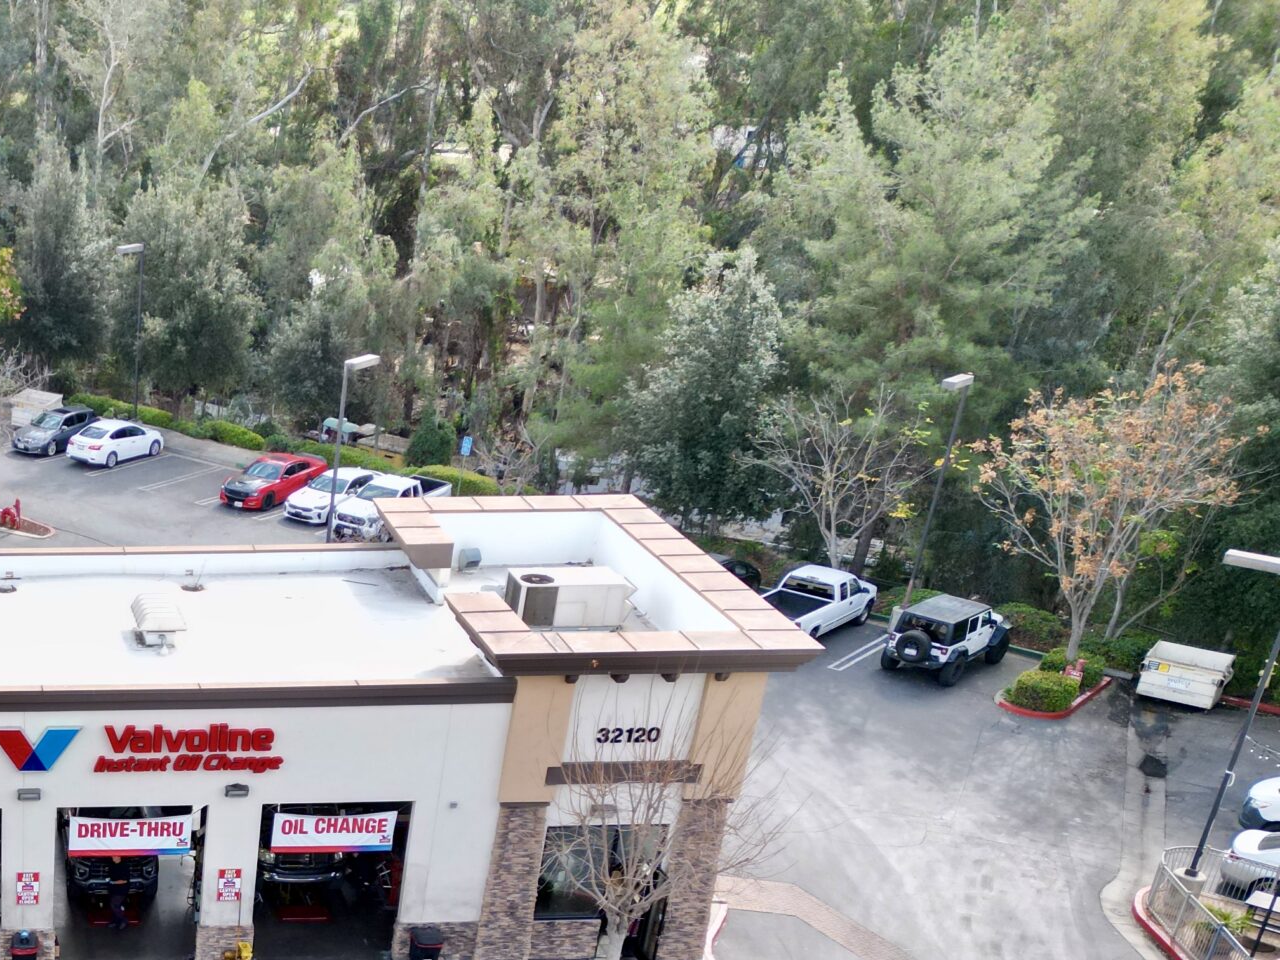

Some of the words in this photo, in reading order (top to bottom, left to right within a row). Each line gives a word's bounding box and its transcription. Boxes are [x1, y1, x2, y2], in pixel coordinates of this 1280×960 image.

[104, 723, 275, 753] Valvoline
[596, 726, 661, 744] 32120
[93, 755, 171, 773] Instant
[172, 754, 203, 772] Oil
[203, 754, 284, 773] Change
[77, 821, 185, 838] DRIVE-THRU
[281, 819, 308, 835] OIL
[314, 817, 388, 834] CHANGE
